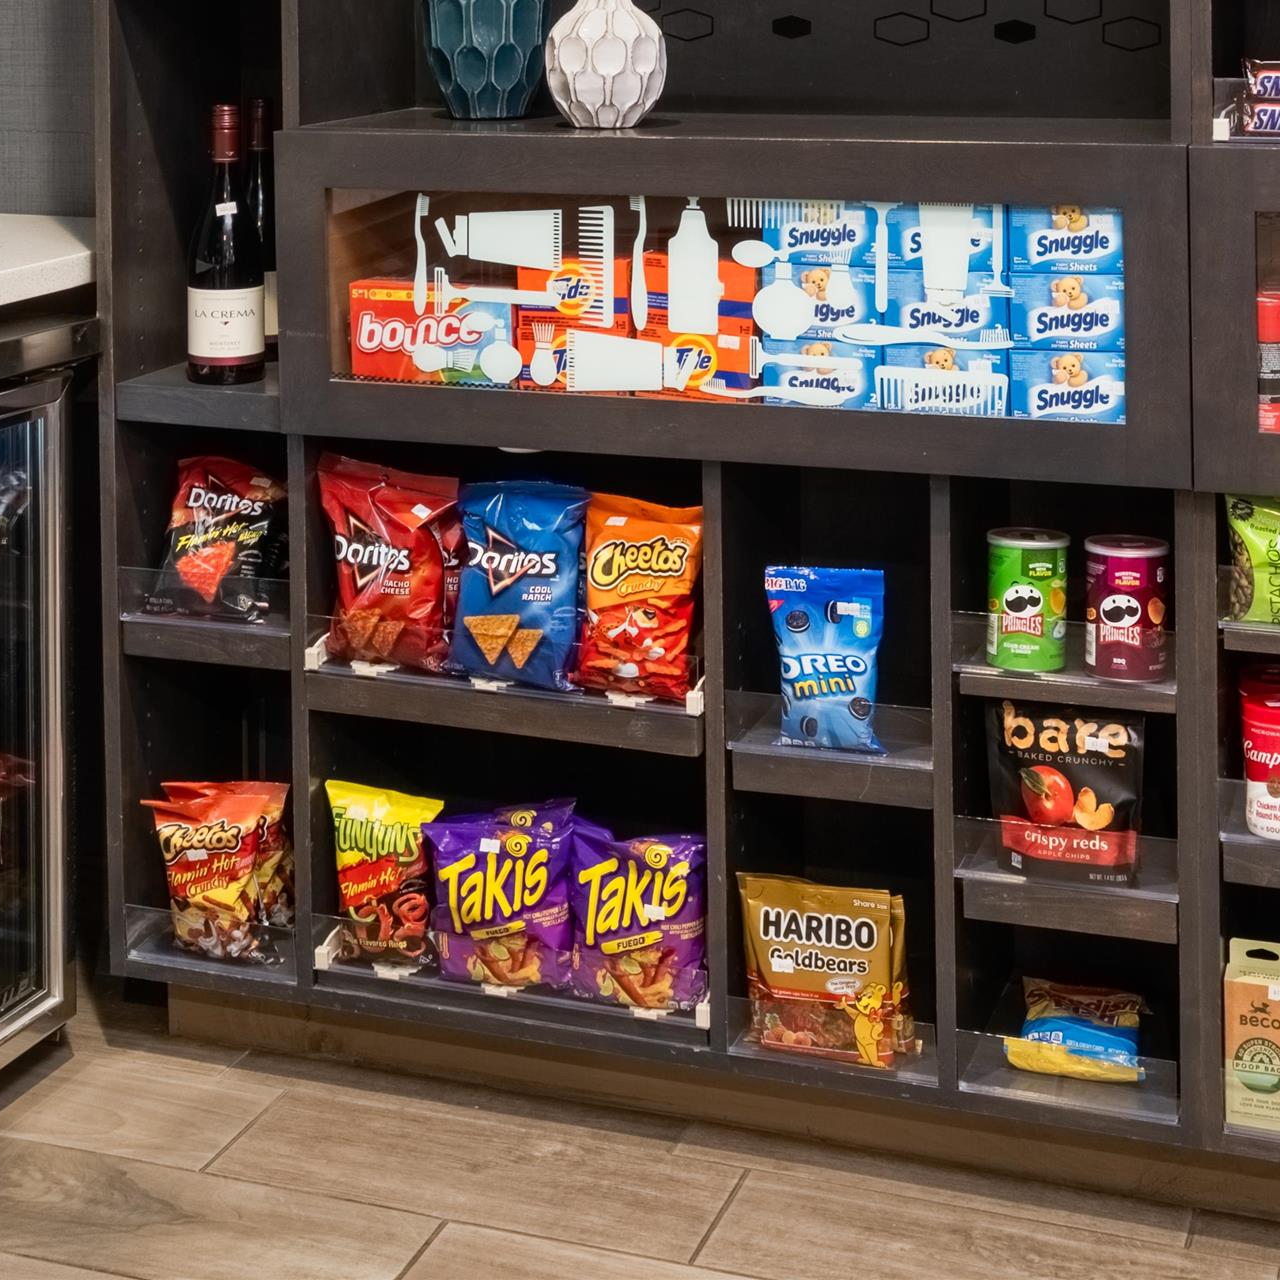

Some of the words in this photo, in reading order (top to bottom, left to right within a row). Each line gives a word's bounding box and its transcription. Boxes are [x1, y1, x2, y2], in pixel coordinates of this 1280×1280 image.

[787, 223, 857, 248] Snuggle
[1035, 229, 1110, 257] Snuggle
[1069, 261, 1098, 272] Sheets
[194, 308, 208, 318] LA
[210, 308, 256, 319] CREMA
[1035, 309, 1110, 334] Snuggle
[1069, 339, 1098, 350] Sheets
[1035, 385, 1110, 412] Snuggle
[187, 486, 265, 517] Doritos
[335, 535, 411, 572] Doritos
[468, 541, 557, 576] Doritos
[590, 536, 689, 589] Cheetos
[380, 586, 412, 596] CHEESE
[382, 579, 411, 589] NACHO
[529, 586, 553, 595] COOL
[616, 578, 666, 597] Crunchy
[784, 578, 807, 592] BAG
[521, 592, 553, 602] RANCH
[1001, 613, 1042, 636] PRINGLES
[1099, 623, 1141, 646] PRINGLES
[781, 654, 867, 680] OREO
[793, 674, 856, 698] mini
[1001, 699, 1129, 759] bare
[1017, 751, 1053, 763] BAKED
[1057, 755, 1114, 767] CRUNCHY
[1256, 799, 1277, 812] Chicken
[157, 818, 244, 866] Cheetos
[1024, 829, 1069, 851] crispy
[1072, 834, 1109, 852] reds
[212, 853, 240, 872] Hot
[1037, 849, 1063, 858] APPLE
[1065, 851, 1091, 861] CHIPS
[437, 847, 550, 936] Takis
[577, 857, 689, 947] Takis
[852, 898, 876, 909] Share
[760, 906, 878, 951] HARIBO
[616, 936, 646, 950] FUEGO
[1234, 1061, 1262, 1073] POOP
